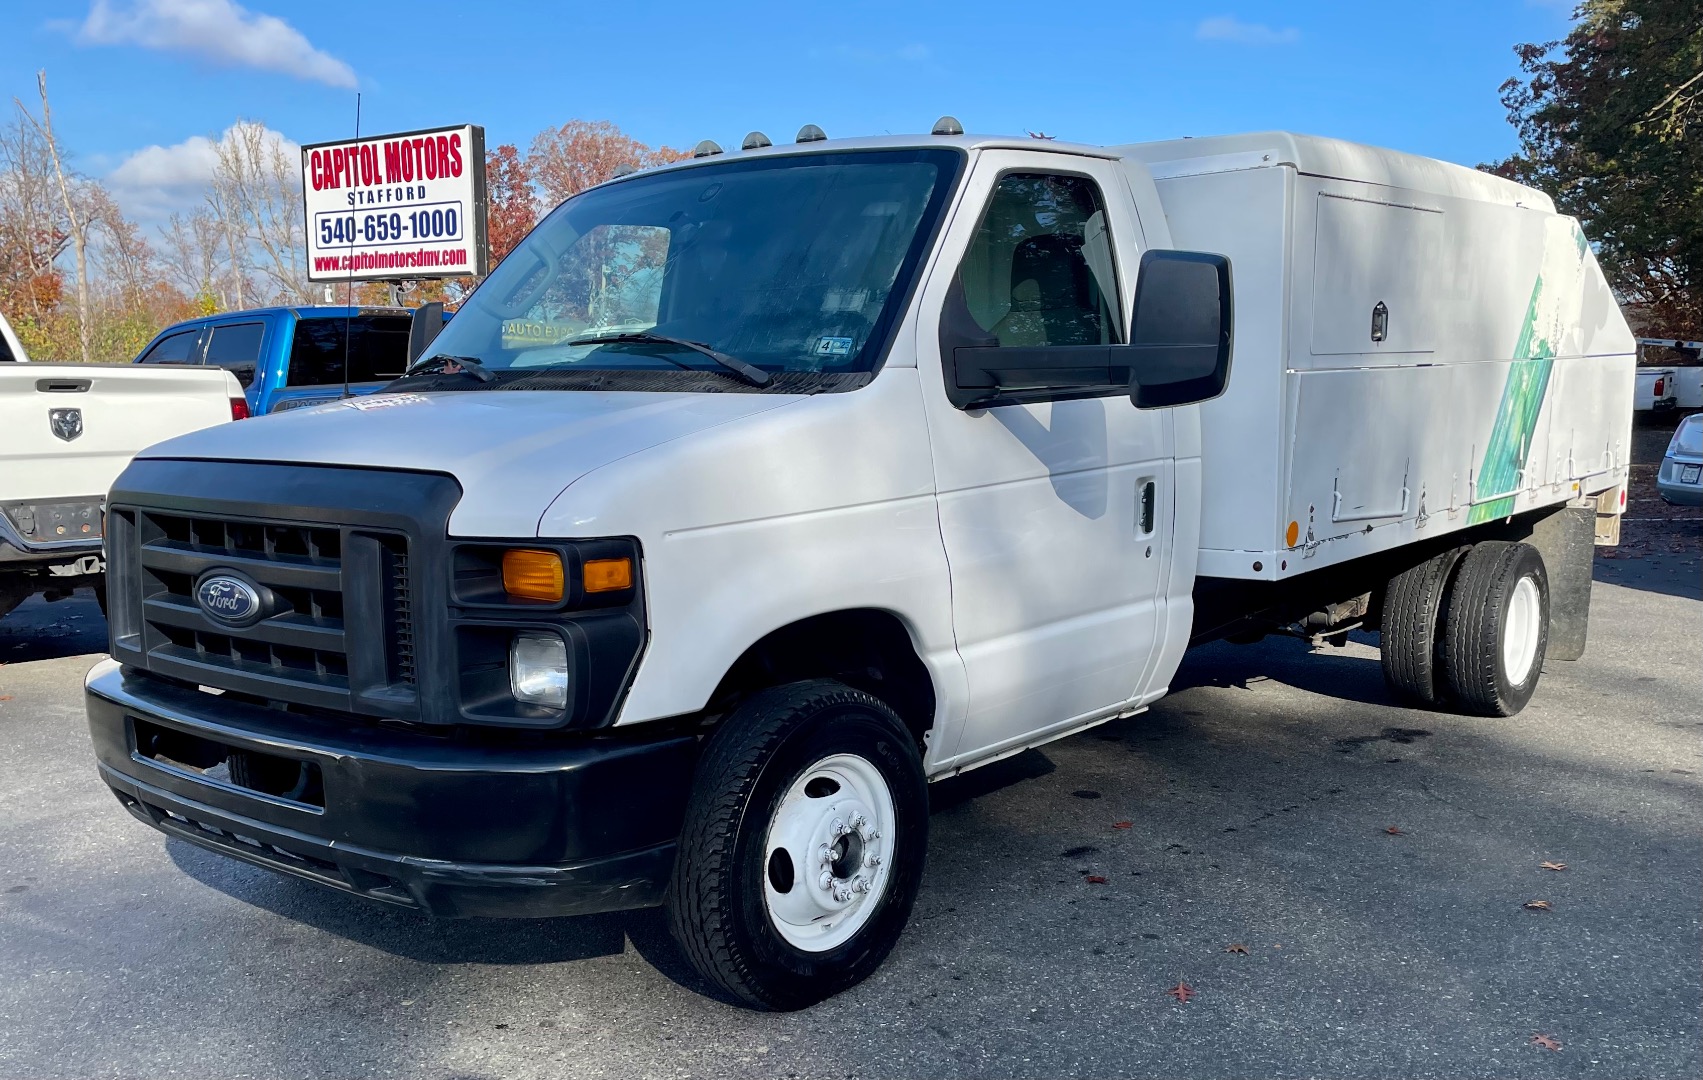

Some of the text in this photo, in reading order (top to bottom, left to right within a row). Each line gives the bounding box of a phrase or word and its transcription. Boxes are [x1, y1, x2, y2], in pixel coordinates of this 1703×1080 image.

[310, 133, 463, 191] CAPITOL MOTORS
[347, 185, 426, 206] STAFFORD
[320, 208, 457, 244] 540-659-1000
[314, 248, 467, 272] www.capitolmotorsdmv.com
[508, 323, 541, 337] AUTO
[207, 584, 239, 610] Ford
